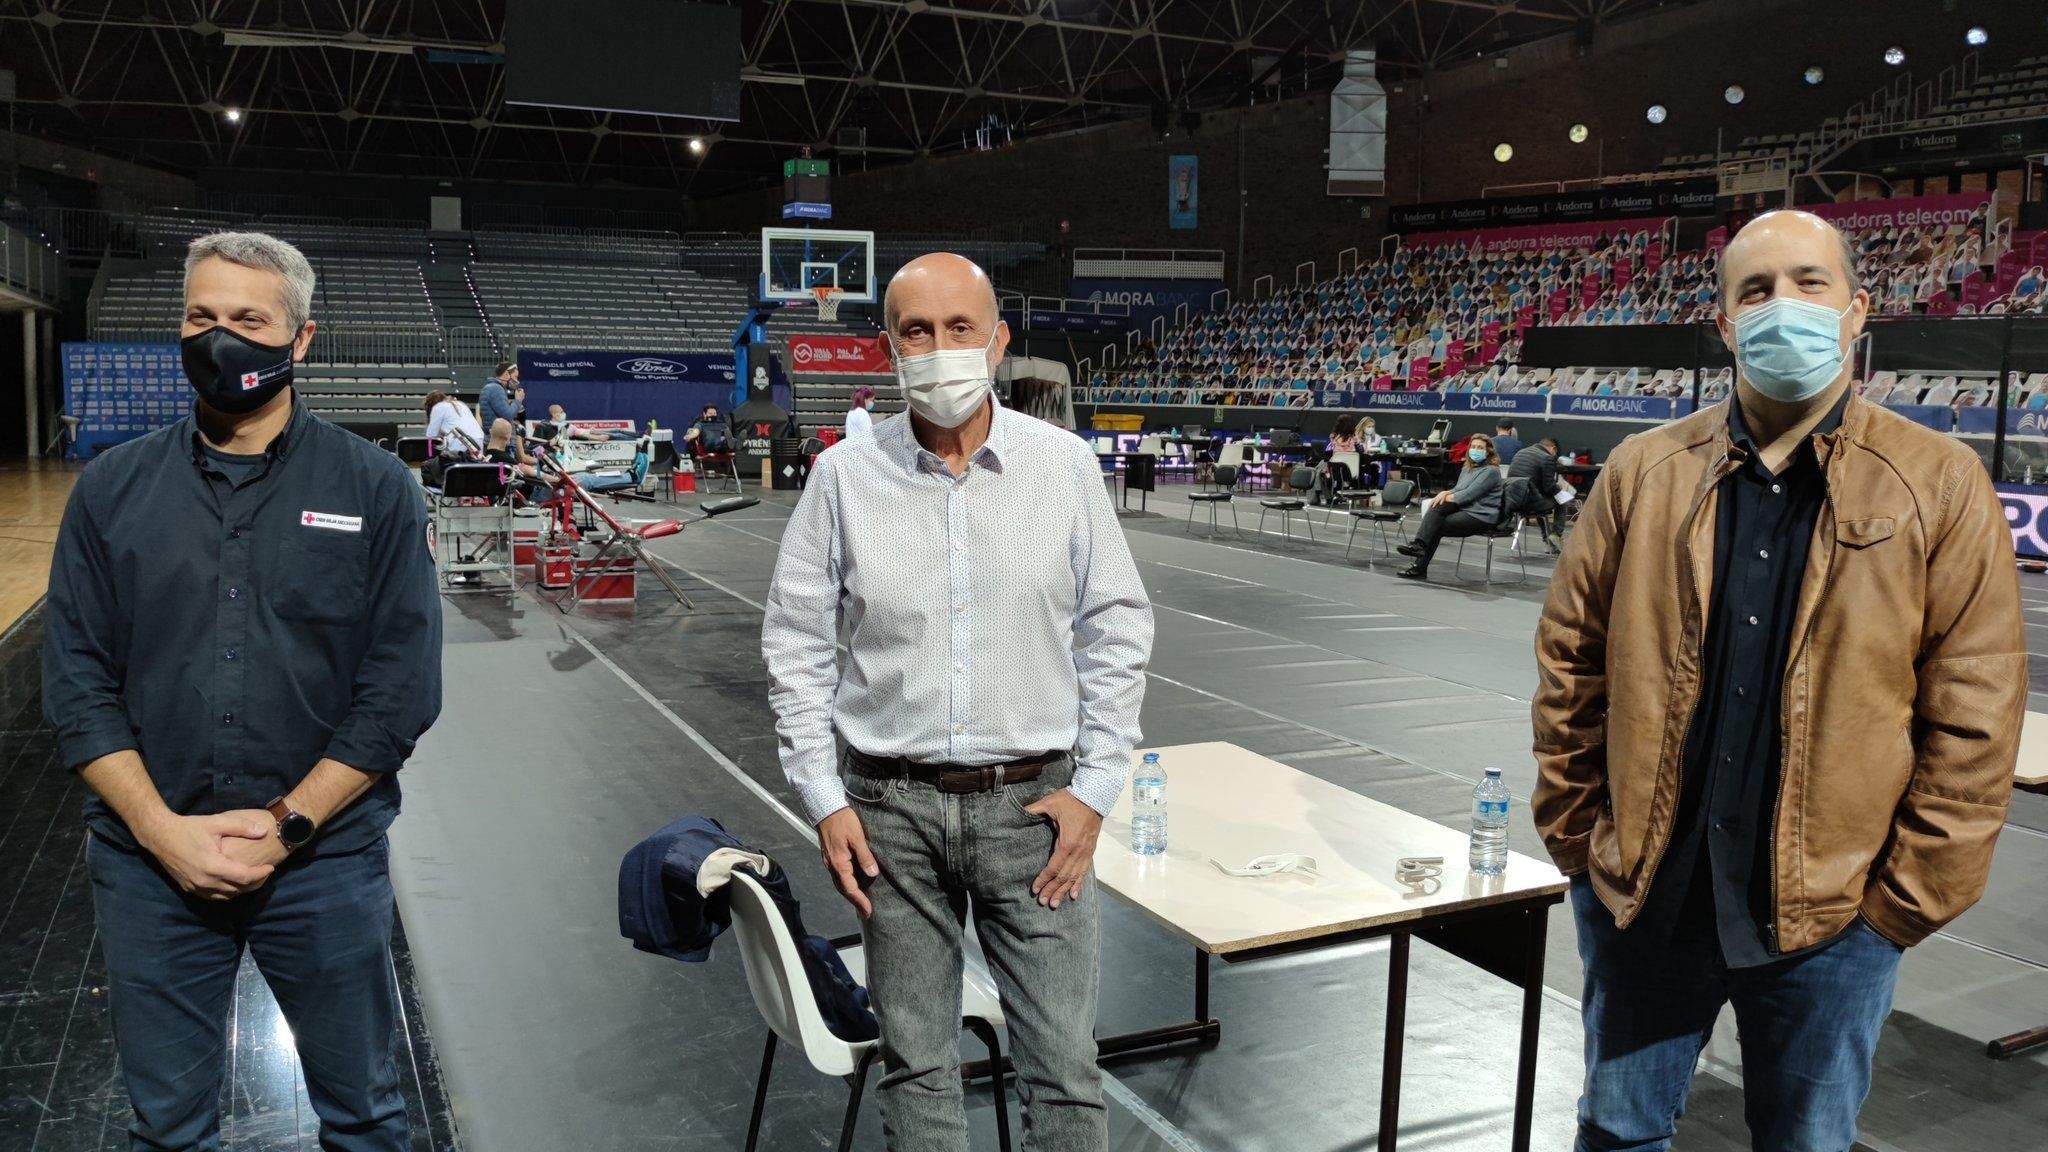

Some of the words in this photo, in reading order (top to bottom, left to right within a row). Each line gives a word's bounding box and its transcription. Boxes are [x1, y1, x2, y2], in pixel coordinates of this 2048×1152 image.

[1912, 134, 1956, 147] Andorra
[1611, 198, 1652, 208] Andorra
[1672, 193, 1714, 204] Andorra
[1502, 205, 1538, 215] Andorra
[1556, 202, 1593, 212] Andorra
[1402, 213, 1436, 222] Andorra
[1451, 209, 1486, 218] Andorra
[1897, 208, 1973, 227] telecom
[1488, 236, 1538, 250] andorra
[1539, 234, 1593, 248] telecom
[567, 360, 596, 368] OFICIAL
[630, 360, 675, 373] Ford
[1377, 394, 1425, 406] MORABANC
[1480, 396, 1517, 408] Andorra
[1581, 398, 1647, 413] MORABANC
